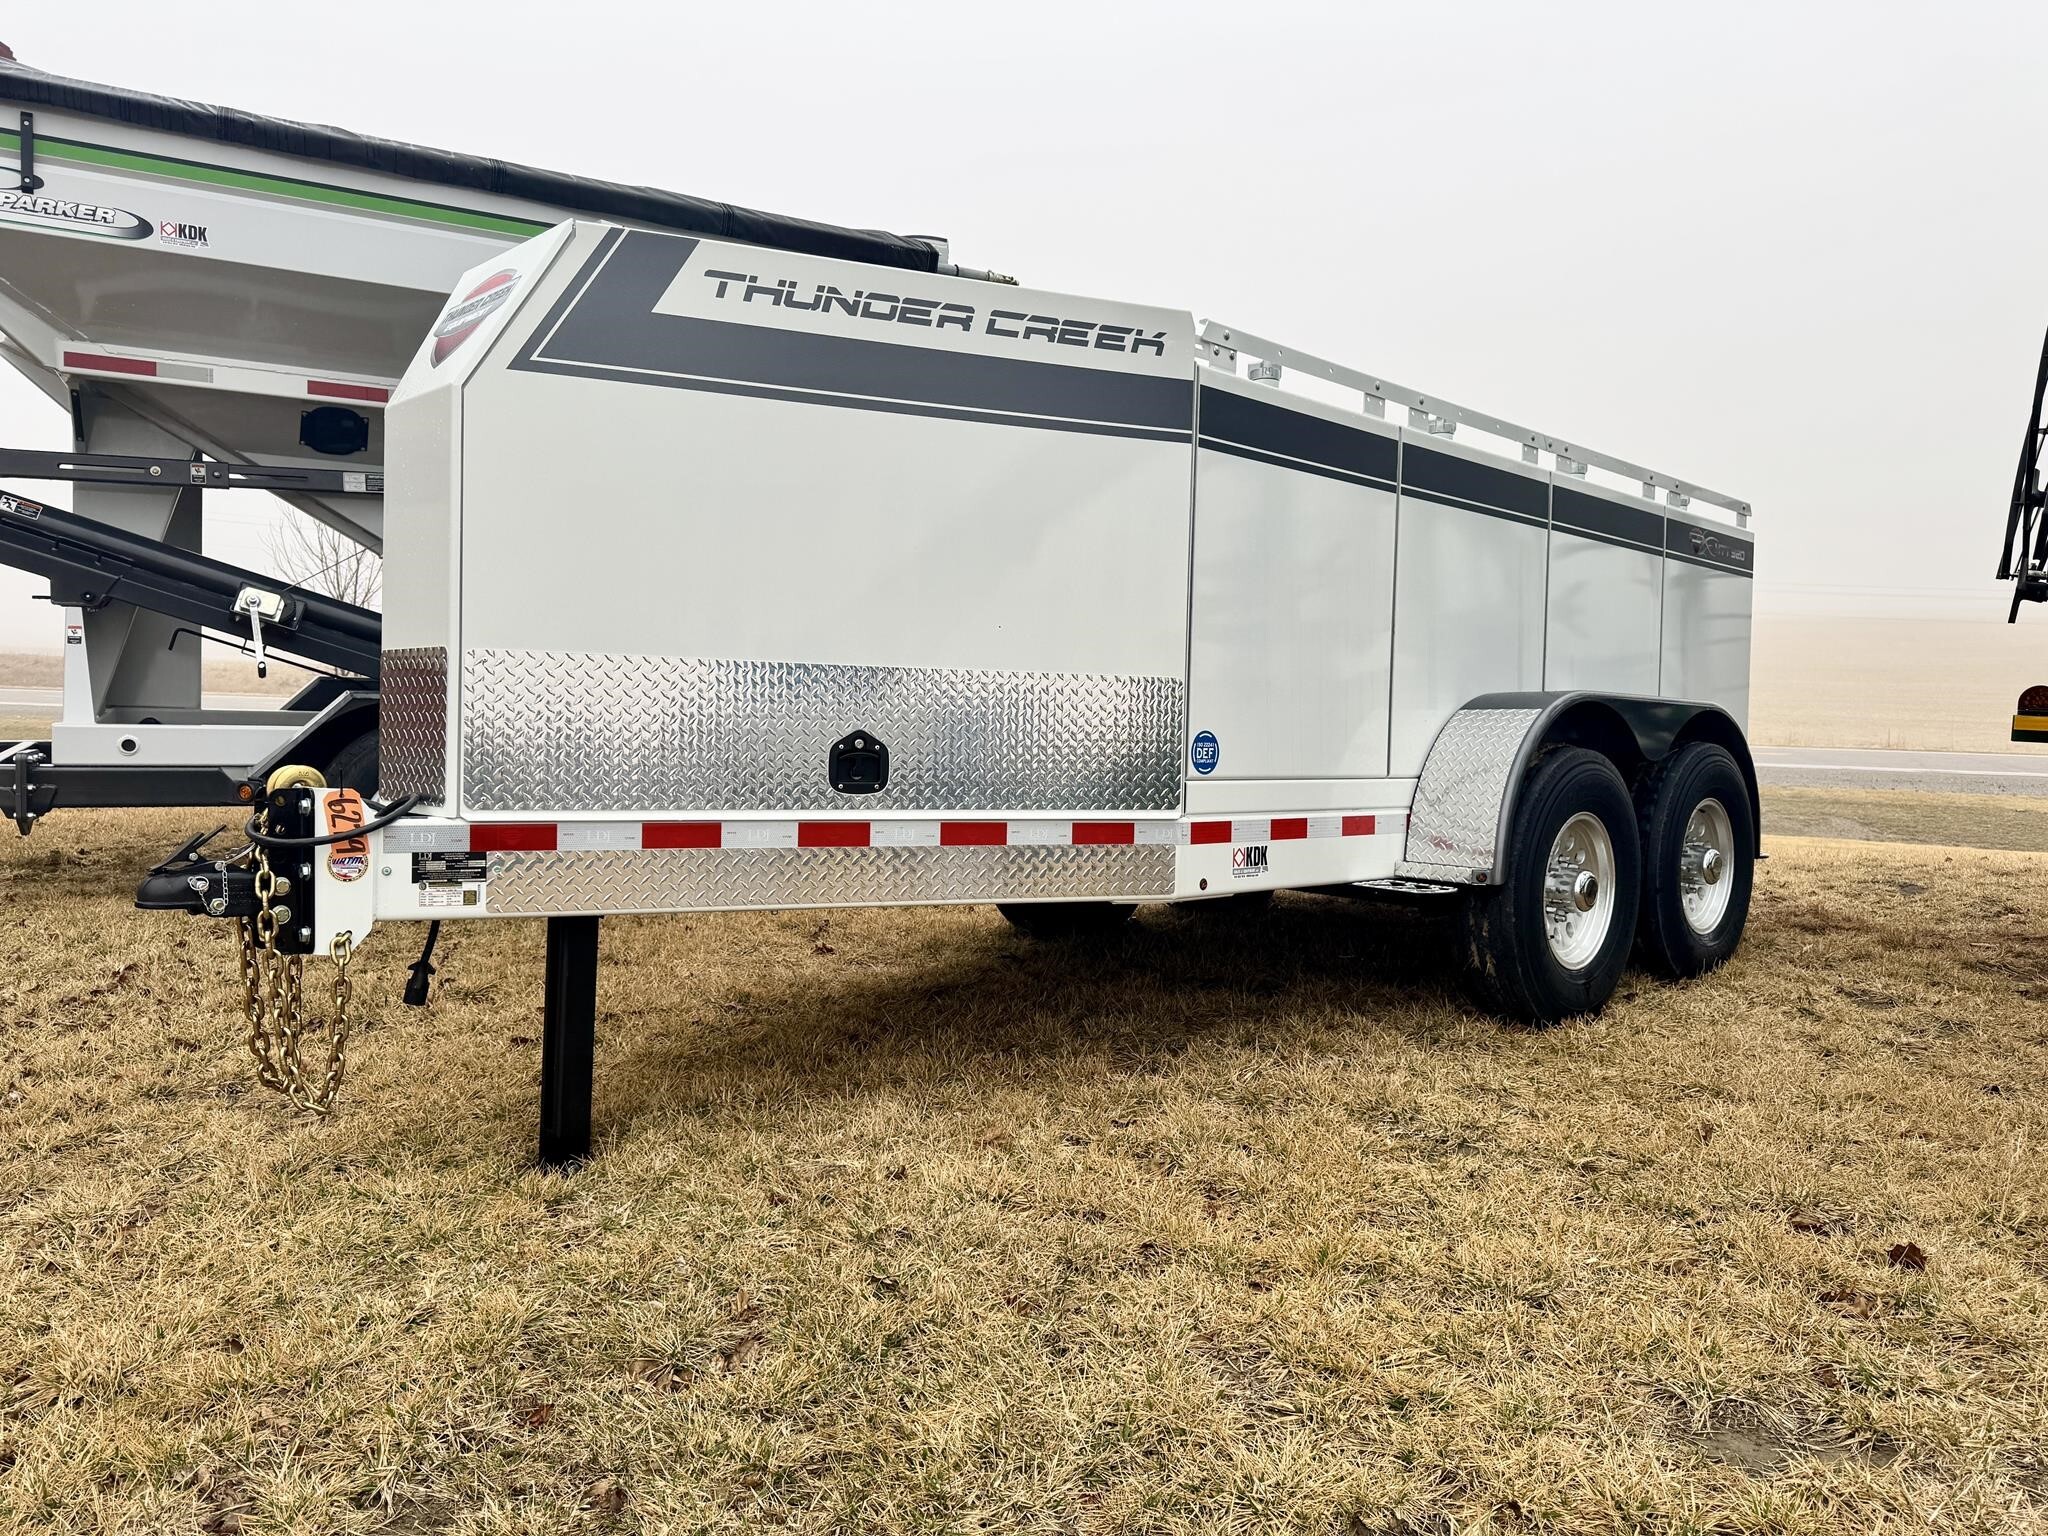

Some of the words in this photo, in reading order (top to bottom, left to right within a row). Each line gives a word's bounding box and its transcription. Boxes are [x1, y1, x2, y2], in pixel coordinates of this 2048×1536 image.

[0, 191, 116, 224] PARKER
[178, 223, 208, 242] KDK
[703, 269, 975, 332] THUNDER
[985, 309, 1167, 357] CREEK
[1196, 747, 1214, 759] DEF
[1246, 845, 1268, 867] KDK
